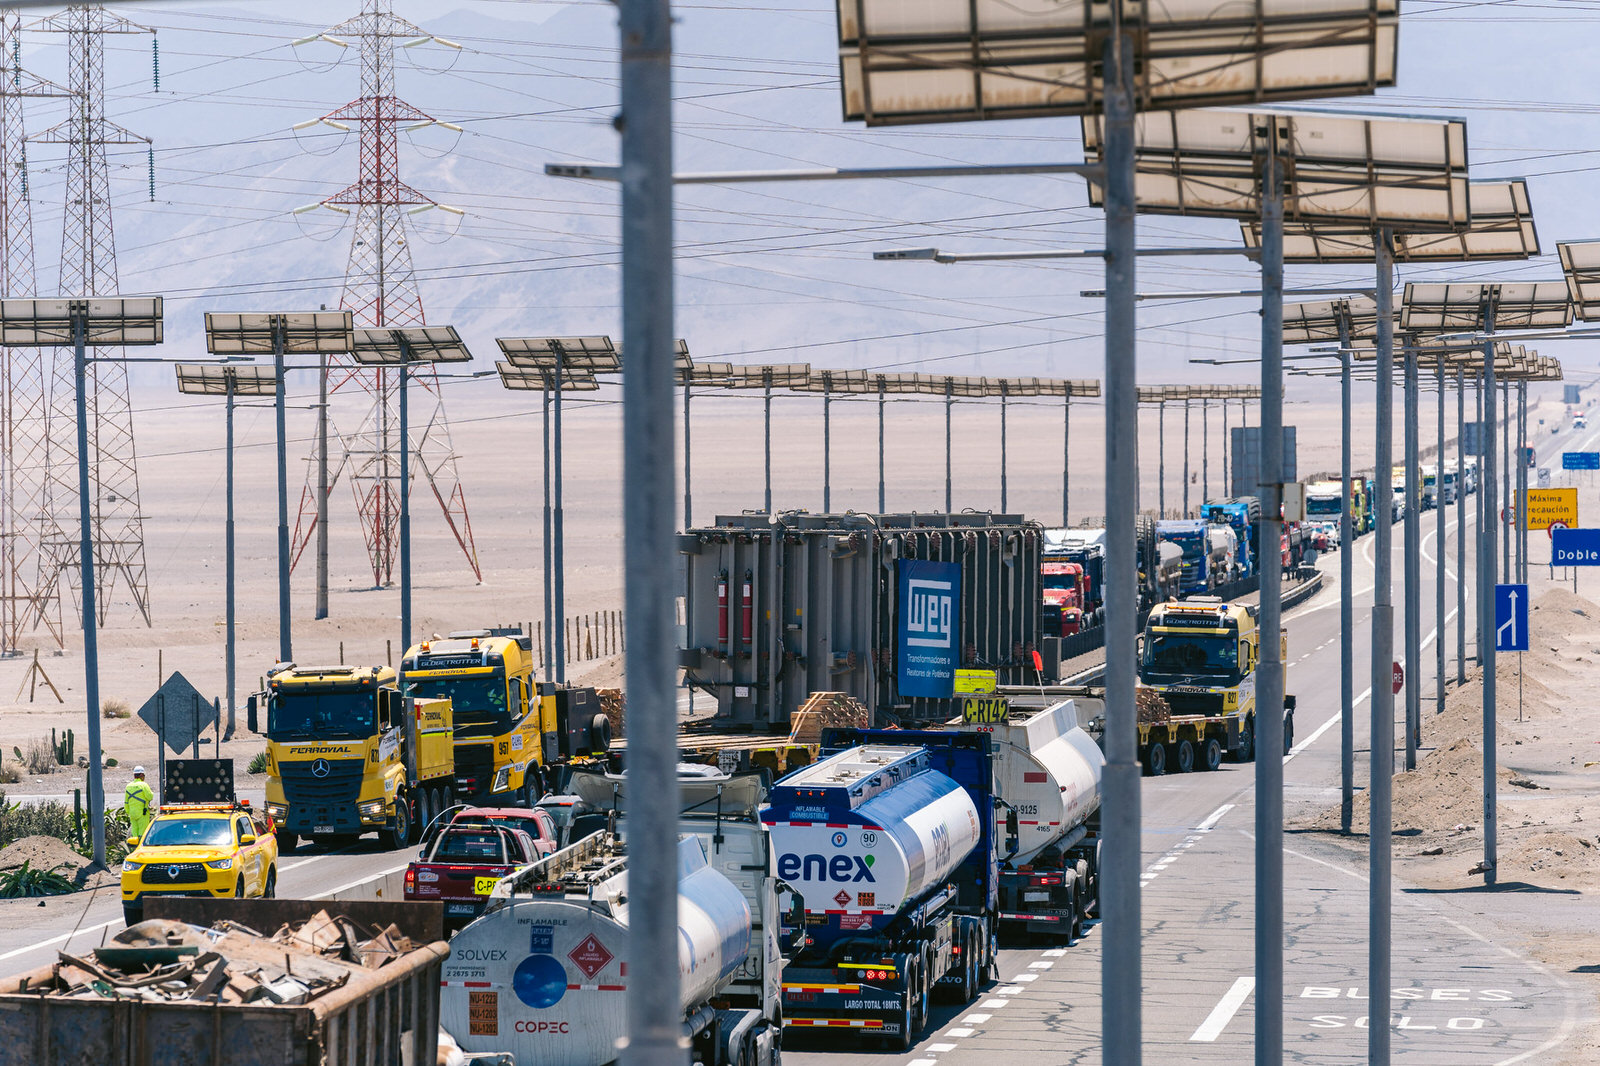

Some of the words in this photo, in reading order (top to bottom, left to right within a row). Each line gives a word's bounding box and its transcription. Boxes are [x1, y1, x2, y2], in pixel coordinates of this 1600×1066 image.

[1558, 549, 1598, 560] Doble
[421, 658, 481, 667] GLOBETROTTER
[907, 653, 946, 665] Transformadores
[964, 699, 1008, 723] C-RT42
[863, 833, 876, 843] 90
[778, 853, 876, 882] enex
[517, 918, 568, 926] INFLAMABLE
[457, 949, 507, 961] SOLVEX
[588, 965, 594, 973] 3
[938, 975, 963, 984] LVO
[844, 1000, 863, 1009] LARGO
[864, 1001, 881, 1009] TOTAL
[514, 1021, 569, 1034] COPEC
